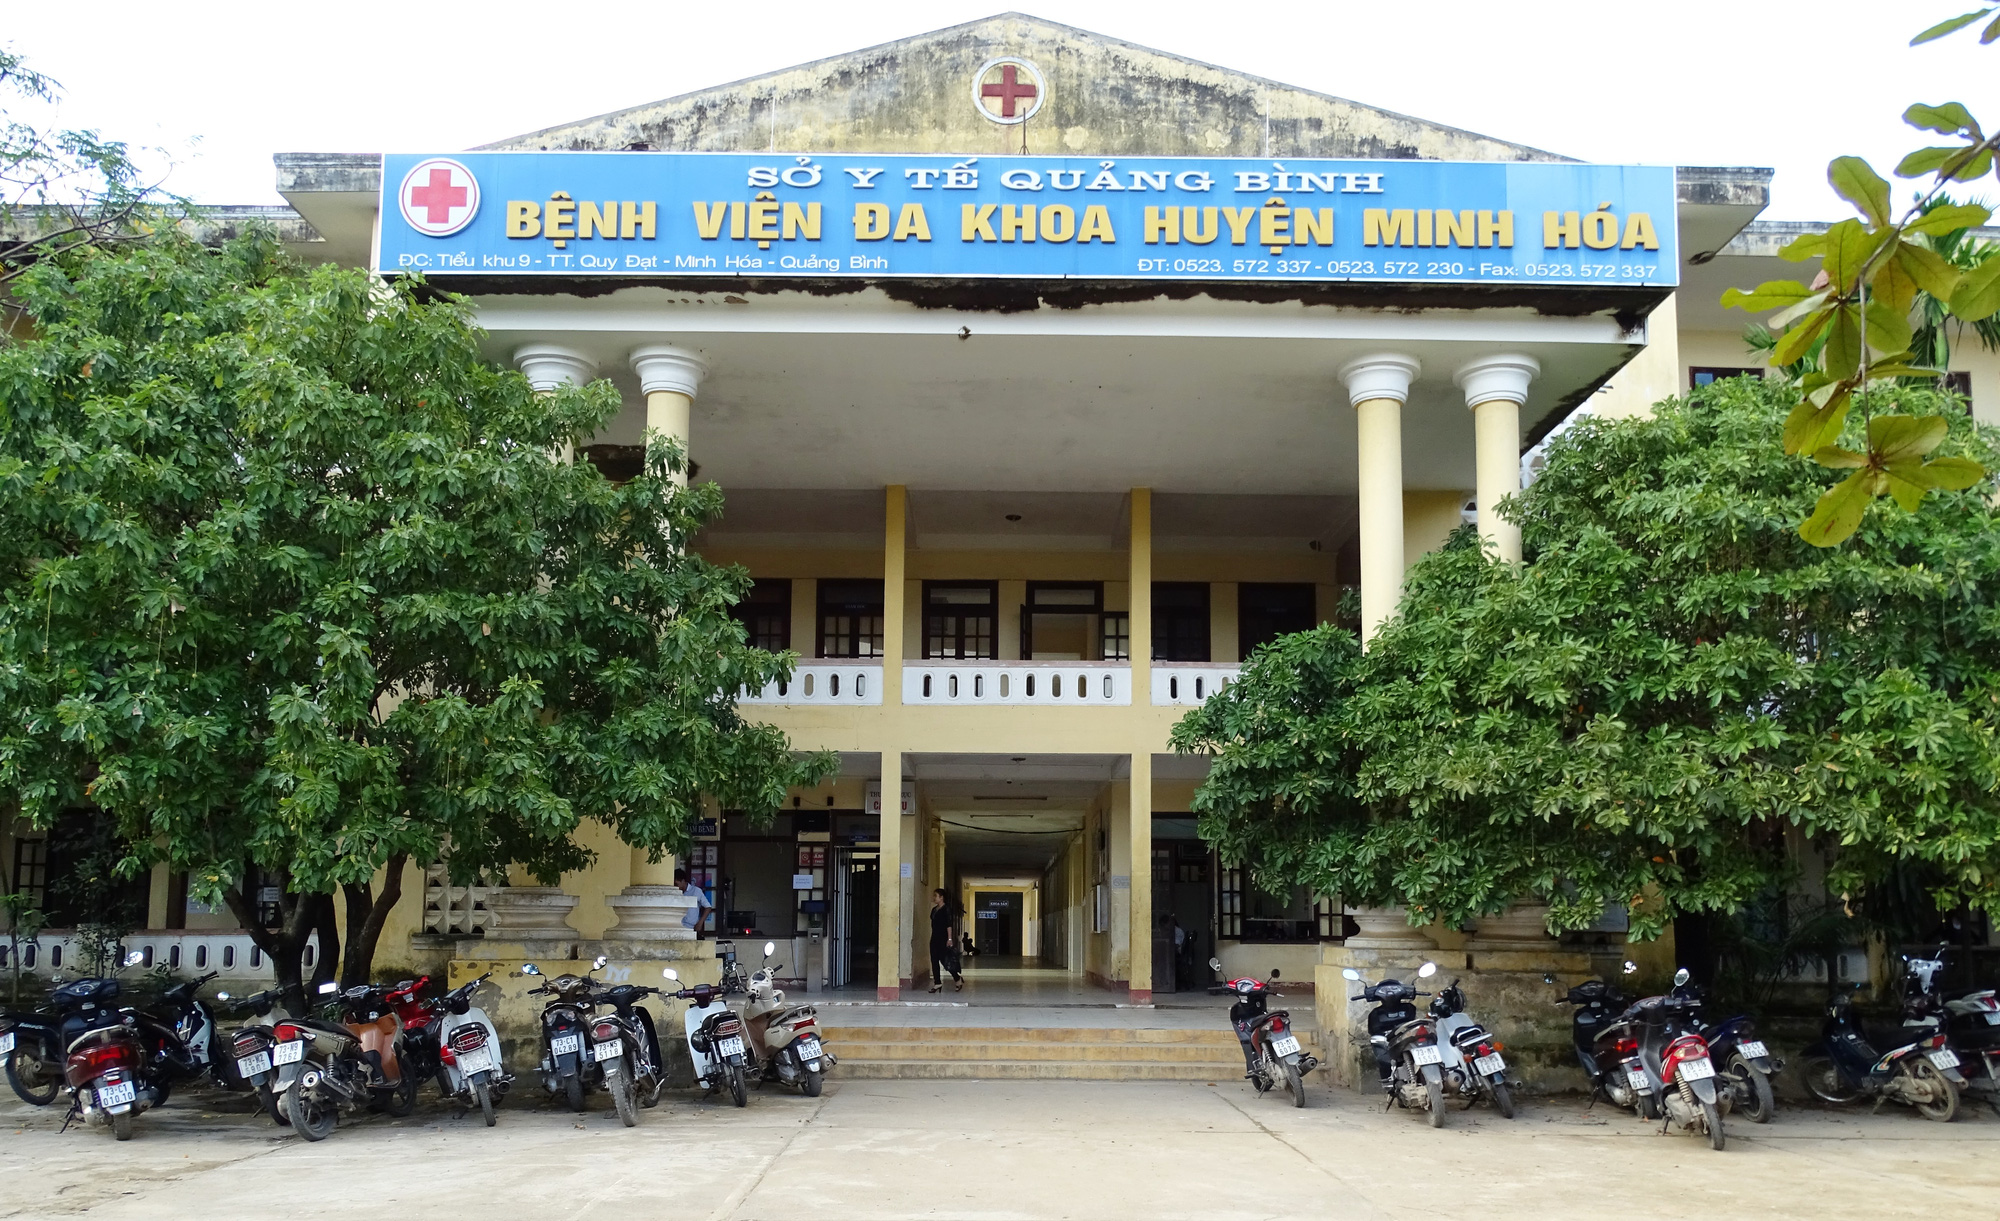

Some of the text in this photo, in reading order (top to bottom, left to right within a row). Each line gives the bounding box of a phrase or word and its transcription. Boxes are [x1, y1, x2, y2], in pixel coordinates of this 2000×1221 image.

[747, 156, 1384, 194] SỞ Y TẾ QUẢNG BÌNH
[505, 190, 1660, 256] BỆNH VIỆN ĐA KHOA HUYỆN MINH HÓA
[398, 253, 433, 267] ĐC:
[437, 251, 475, 267] Tiểu
[483, 254, 516, 267] khu
[518, 254, 531, 267] 9
[546, 254, 575, 267] TT.
[580, 254, 618, 270] Quy
[625, 255, 658, 270] Đạt
[675, 255, 716, 268] Minh
[725, 254, 762, 268] Hóa
[780, 254, 840, 272] Quảng
[850, 255, 888, 269] Bình
[1137, 258, 1170, 272] ĐT:
[1174, 259, 1225, 272] 0523.
[1233, 260, 1269, 273] 572
[1276, 260, 1311, 273] 337
[1327, 261, 1377, 274] 0523.
[1384, 261, 1419, 275] 572
[1426, 262, 1463, 275] 230
[1480, 263, 1519, 276] Fax:
[1524, 263, 1576, 277] 0523.
[1580, 264, 1616, 278] 572
[1621, 264, 1657, 278] 337
